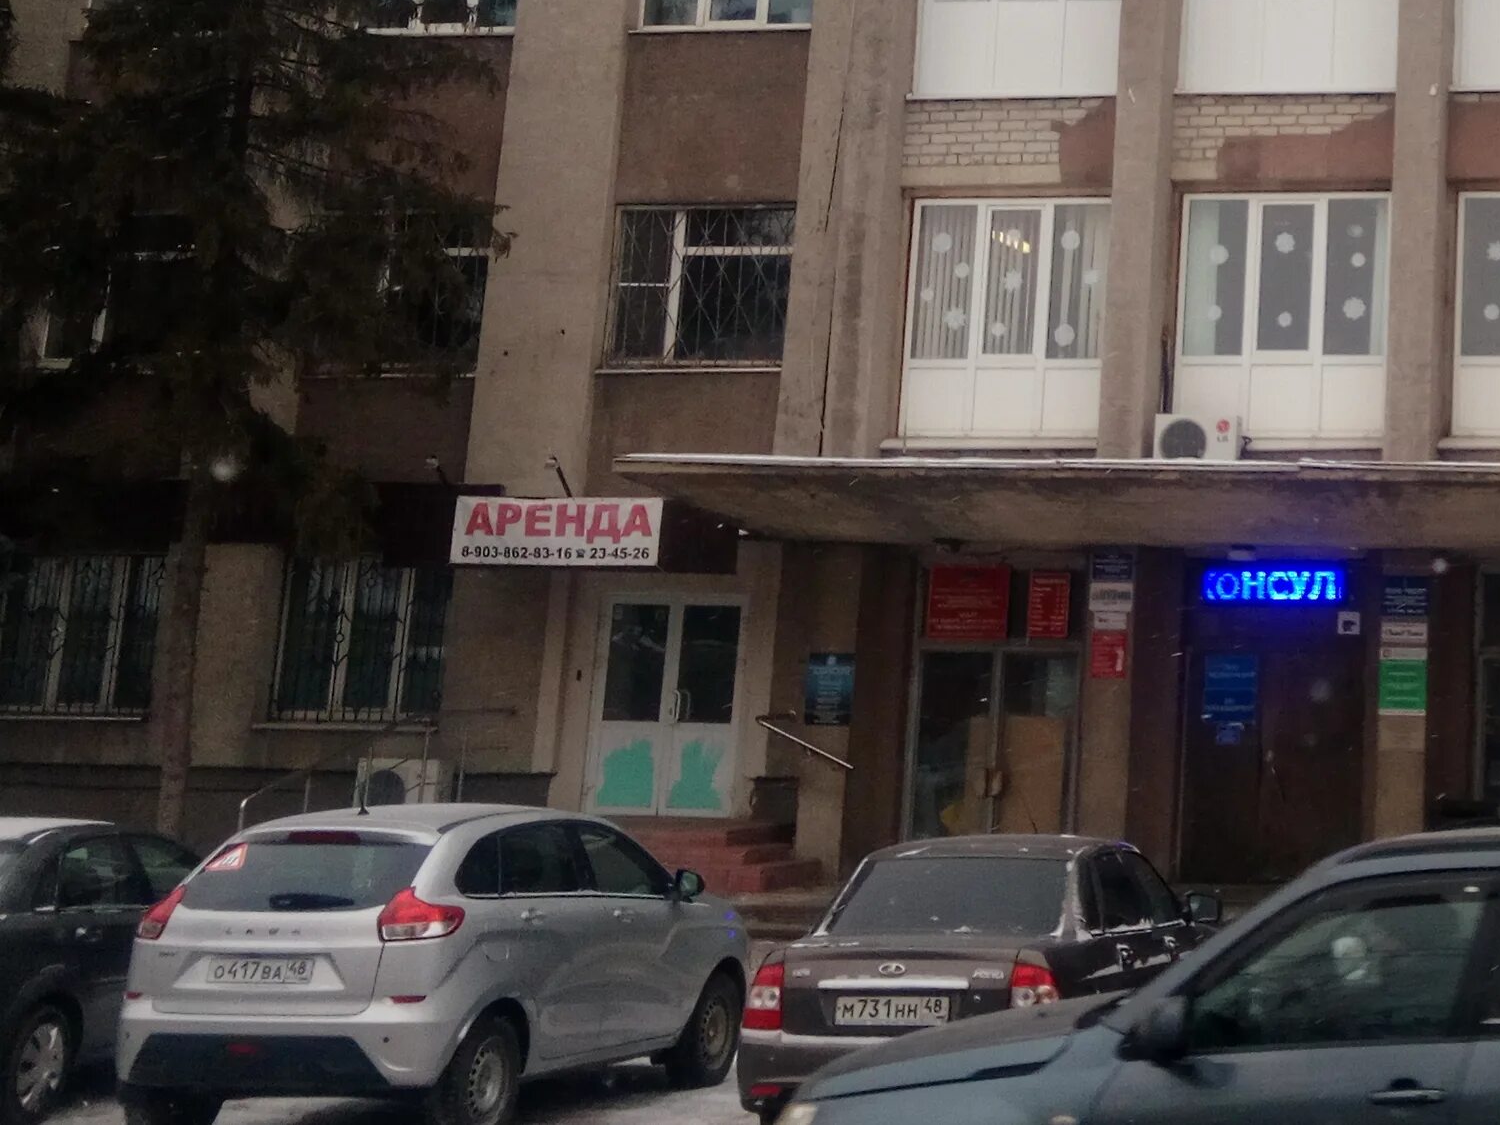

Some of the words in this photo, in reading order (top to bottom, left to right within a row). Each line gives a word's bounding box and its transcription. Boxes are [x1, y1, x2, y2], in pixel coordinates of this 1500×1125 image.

[464, 502, 653, 544] АРЕНДА
[461, 545, 572, 560] 8-903-862-83-16
[589, 546, 650, 560] 23-45-26
[288, 960, 306, 976] 48
[841, 998, 918, 1019] М731НН
[924, 998, 942, 1013] 48
